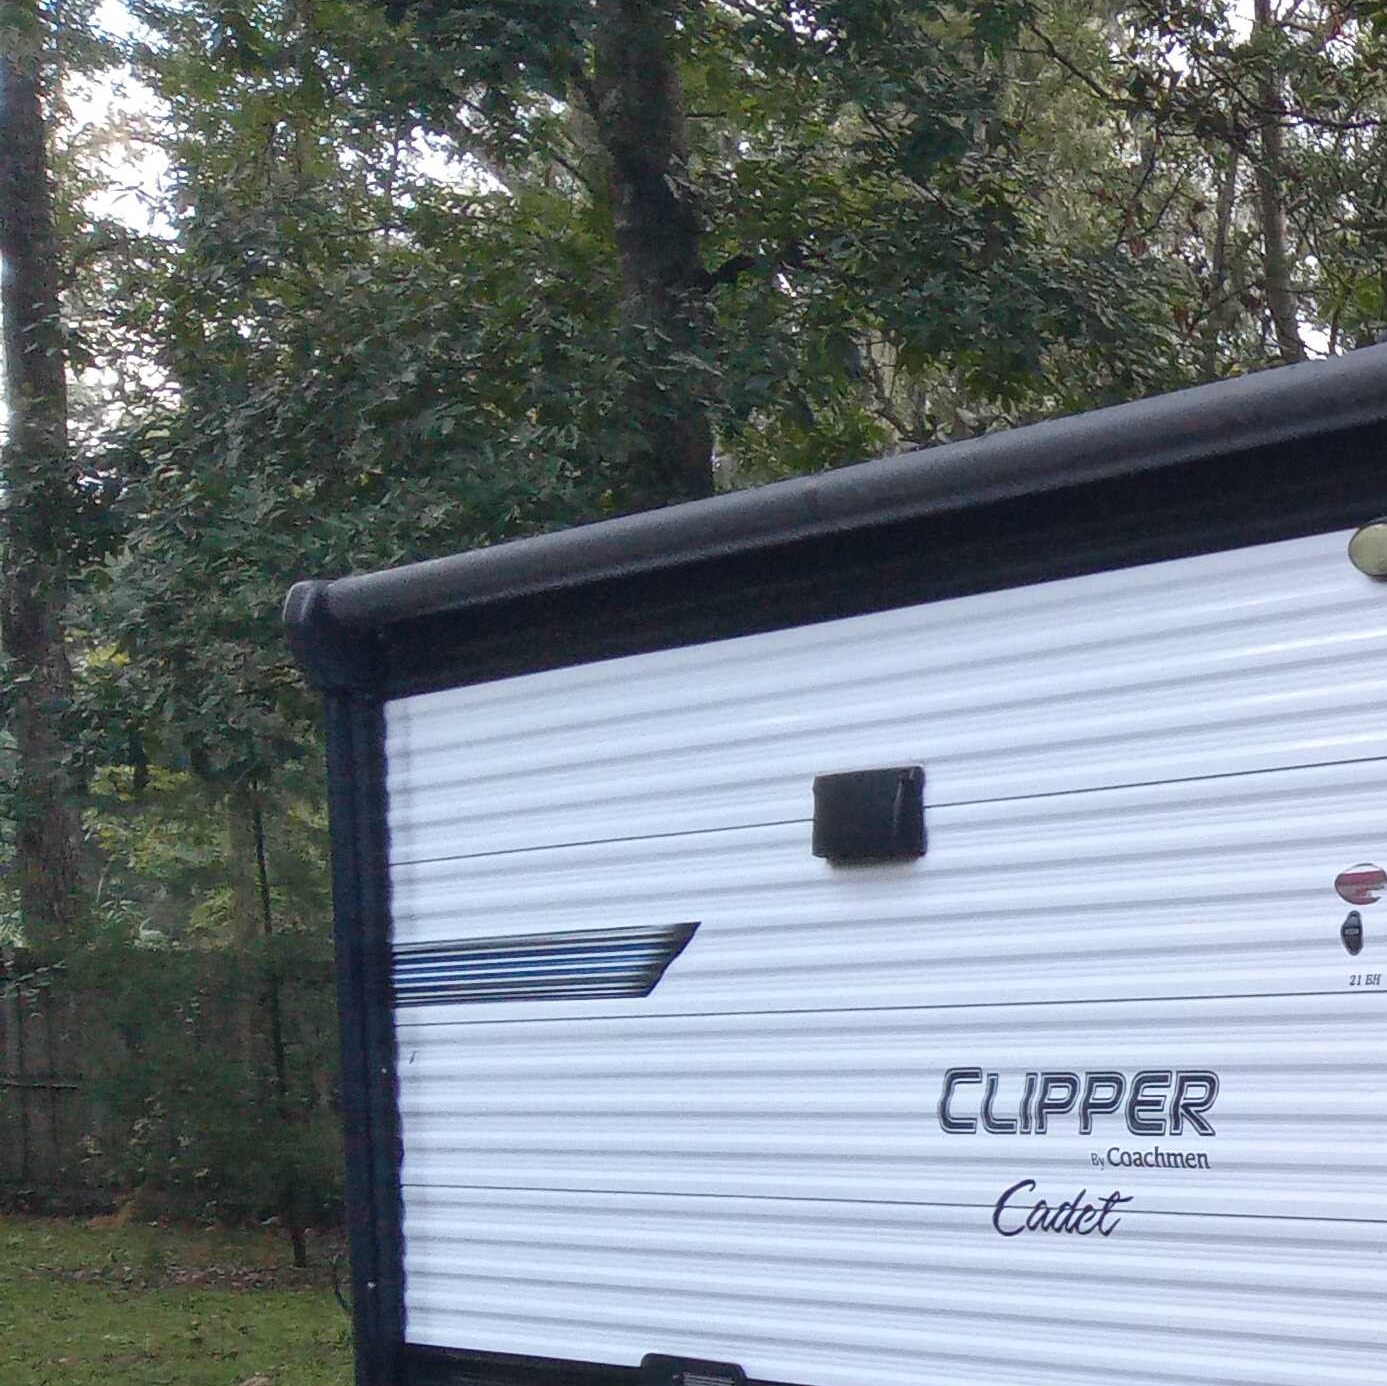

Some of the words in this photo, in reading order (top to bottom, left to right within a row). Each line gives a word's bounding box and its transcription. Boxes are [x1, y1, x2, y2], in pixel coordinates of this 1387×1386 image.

[1349, 974, 1362, 986] 21
[937, 1066, 1220, 1137] CLIPPER
[1090, 1152, 1105, 1171] By
[1106, 1147, 1211, 1170] Coachmen
[992, 1178, 1134, 1237] Cadet
